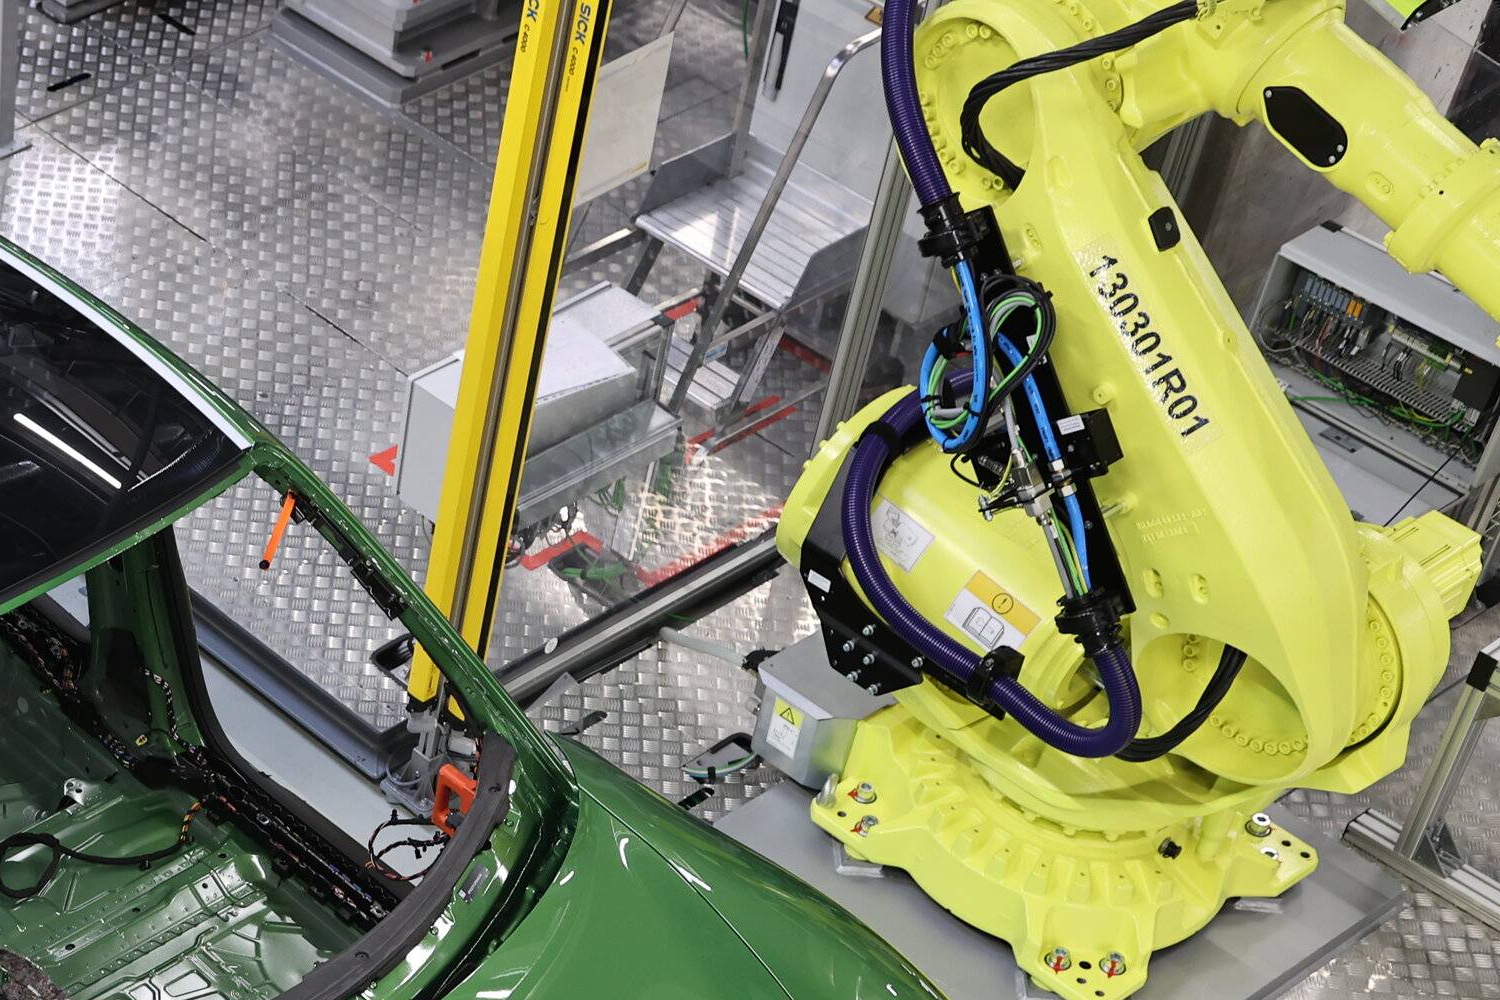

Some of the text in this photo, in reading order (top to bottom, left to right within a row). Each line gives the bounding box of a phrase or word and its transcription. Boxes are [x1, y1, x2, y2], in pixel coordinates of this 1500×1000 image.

[527, 0, 539, 22] CK
[575, 3, 591, 45] SICK
[1089, 255, 1210, 438] 130301R01
